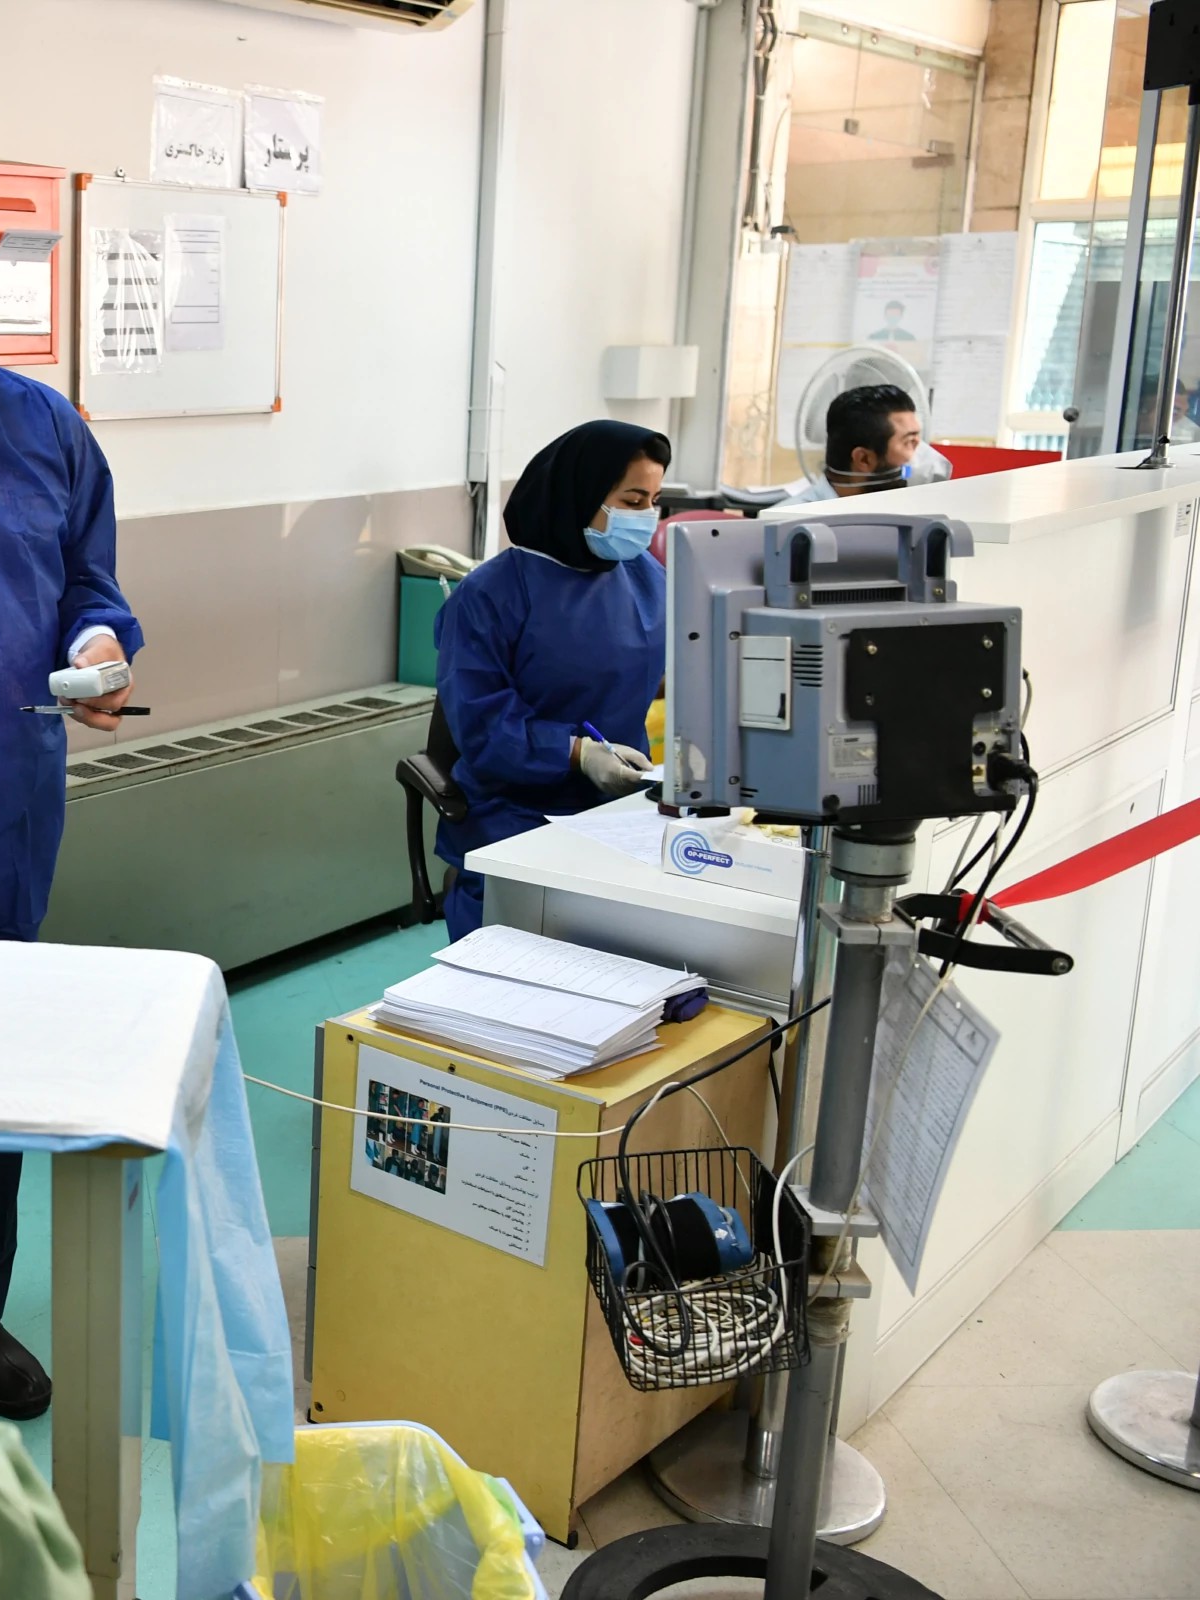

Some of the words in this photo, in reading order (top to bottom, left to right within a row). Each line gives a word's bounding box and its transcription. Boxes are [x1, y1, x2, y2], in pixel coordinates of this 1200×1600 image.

[165, 143, 204, 159] خاکستری
[264, 133, 309, 172] پرستار
[687, 849, 730, 865] OP-PERFECT
[420, 1078, 440, 1090] Personal
[440, 1086, 466, 1099] Protective
[466, 1094, 493, 1108] Equipment
